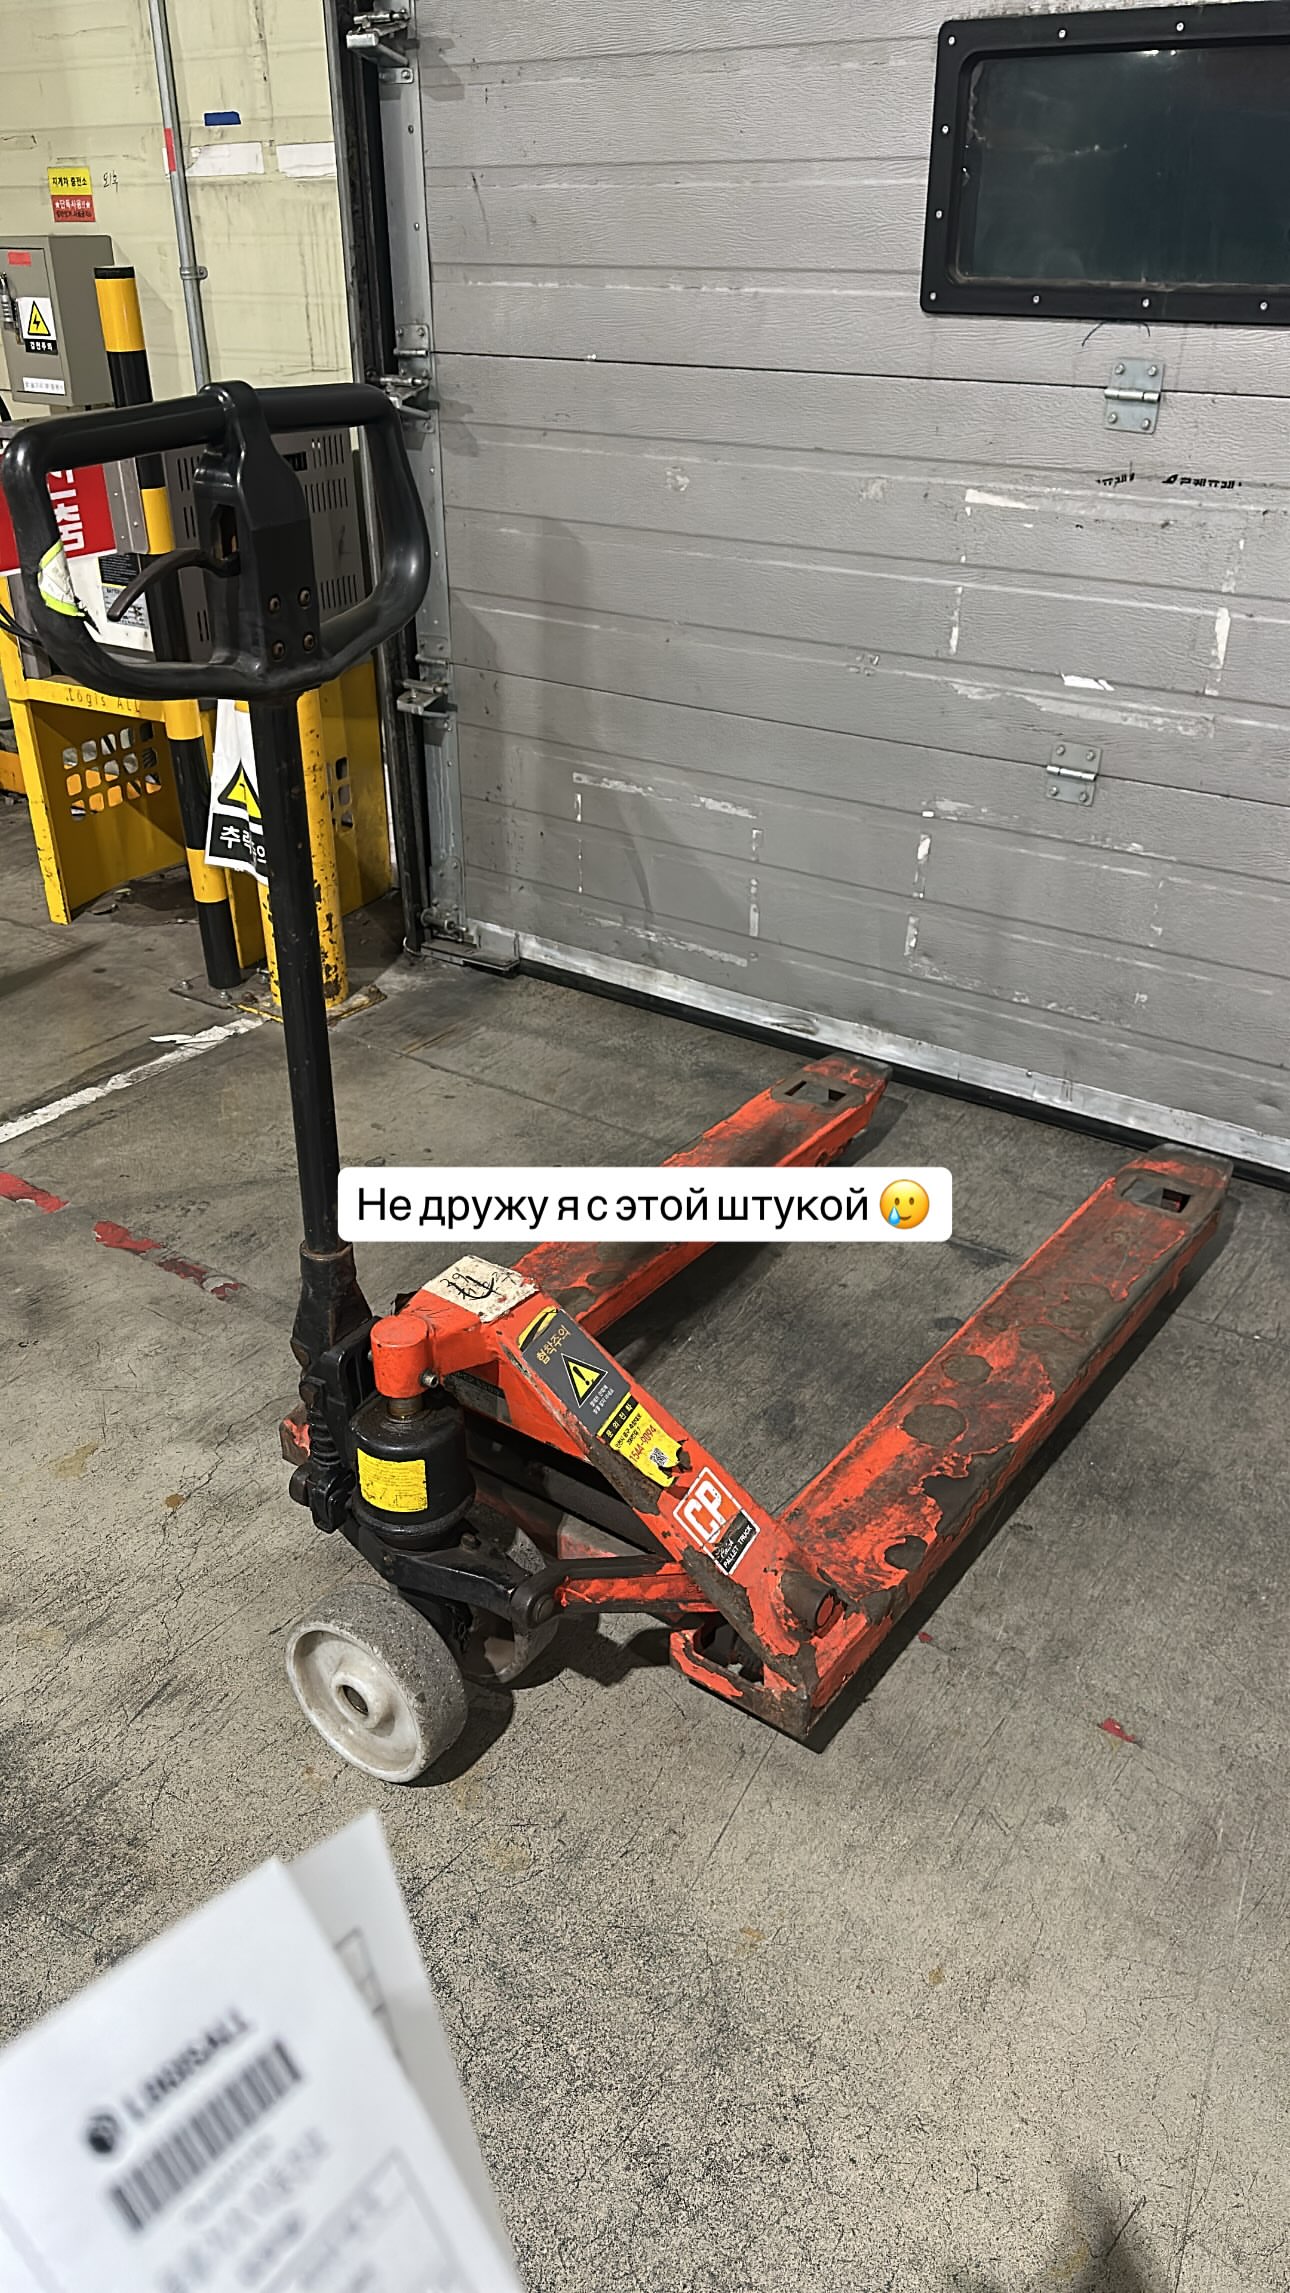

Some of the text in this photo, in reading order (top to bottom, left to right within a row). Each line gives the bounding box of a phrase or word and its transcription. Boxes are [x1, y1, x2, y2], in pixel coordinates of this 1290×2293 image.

[536, 1324, 571, 1365] 협착주의
[683, 1480, 727, 1544] CP
[723, 1545, 739, 1568] PALLET
[737, 1524, 753, 1545] TRUCK
